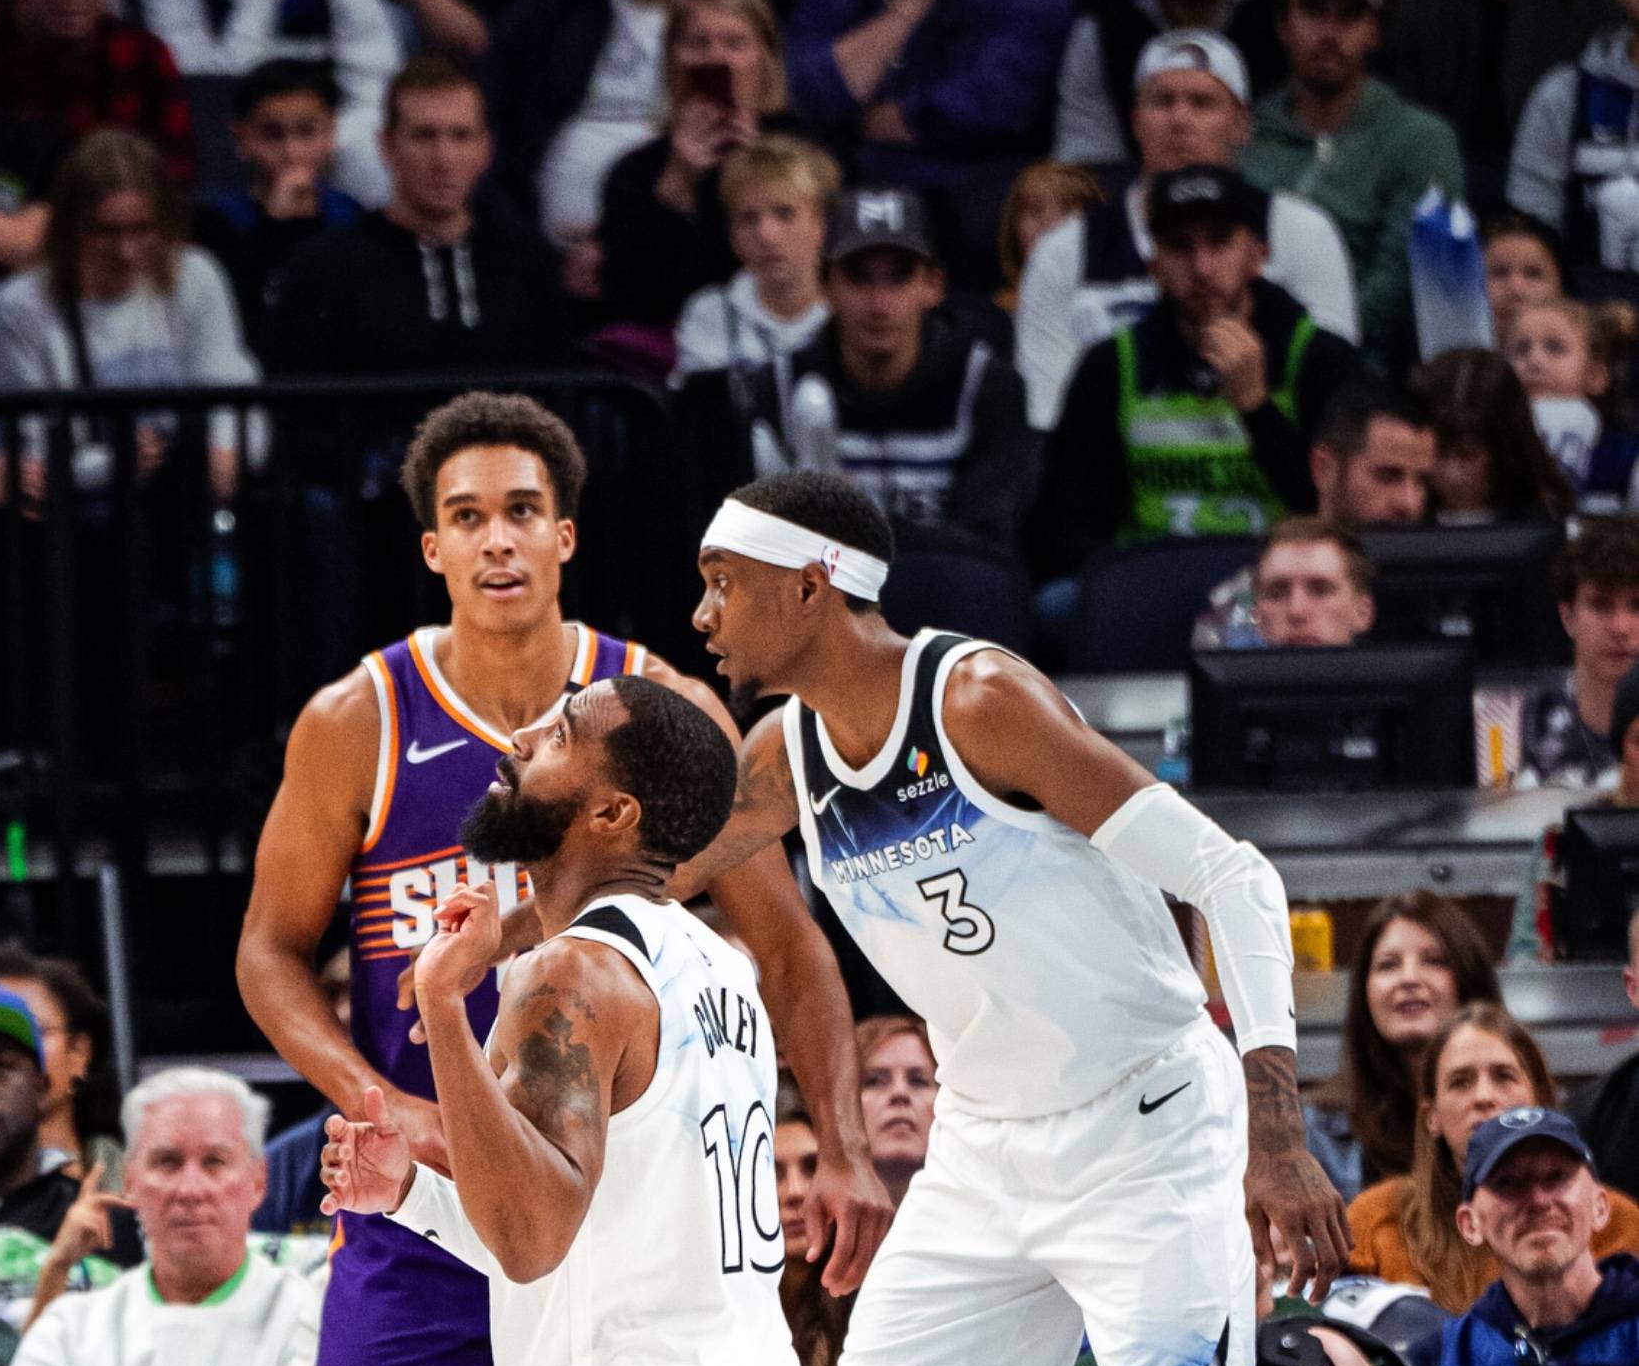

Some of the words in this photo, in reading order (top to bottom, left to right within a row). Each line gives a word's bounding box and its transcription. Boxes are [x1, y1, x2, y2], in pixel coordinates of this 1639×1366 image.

[897, 771, 950, 803] sezzle
[830, 822, 976, 884] MINNESOTA
[915, 867, 996, 956] 3
[700, 1100, 786, 1275] 10
